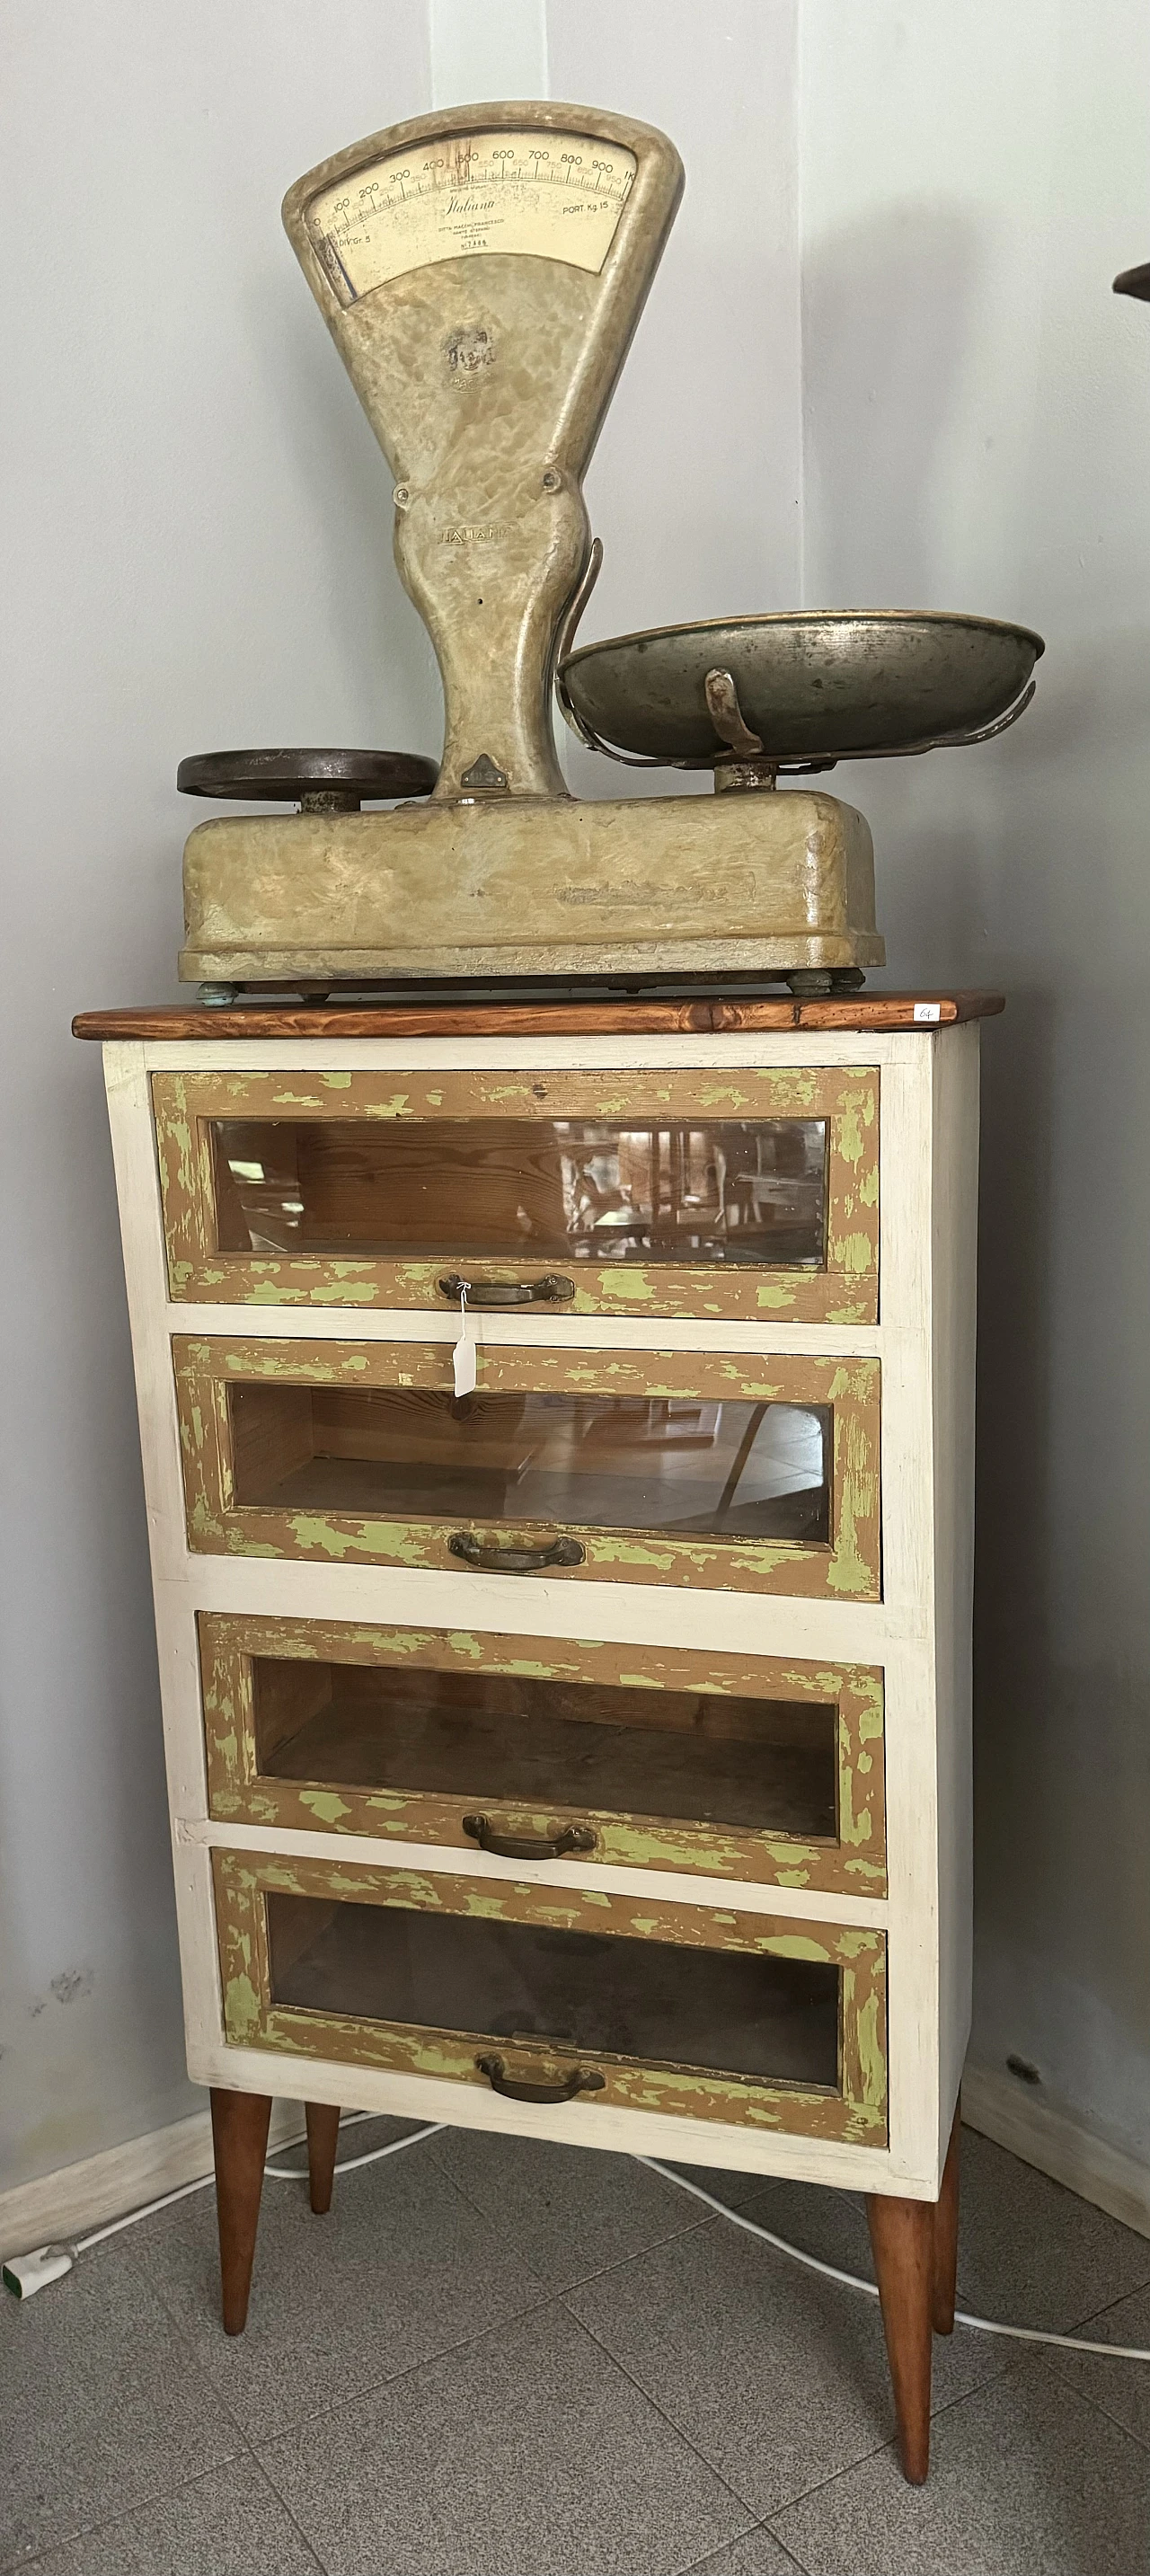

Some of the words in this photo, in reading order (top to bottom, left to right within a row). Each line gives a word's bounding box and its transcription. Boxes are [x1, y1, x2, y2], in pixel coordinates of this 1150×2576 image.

[314, 217, 321, 226] 0
[333, 198, 350, 213] 100
[358, 182, 379, 199] 200
[389, 169, 410, 182] 300
[422, 159, 444, 171] 400
[457, 151, 479, 164] 500
[492, 149, 515, 160] 600
[528, 150, 550, 161] 700
[560, 153, 583, 165] 800
[591, 160, 614, 173] 900
[599, 200, 609, 209] 15
[919, 1007, 933, 1020] 64
